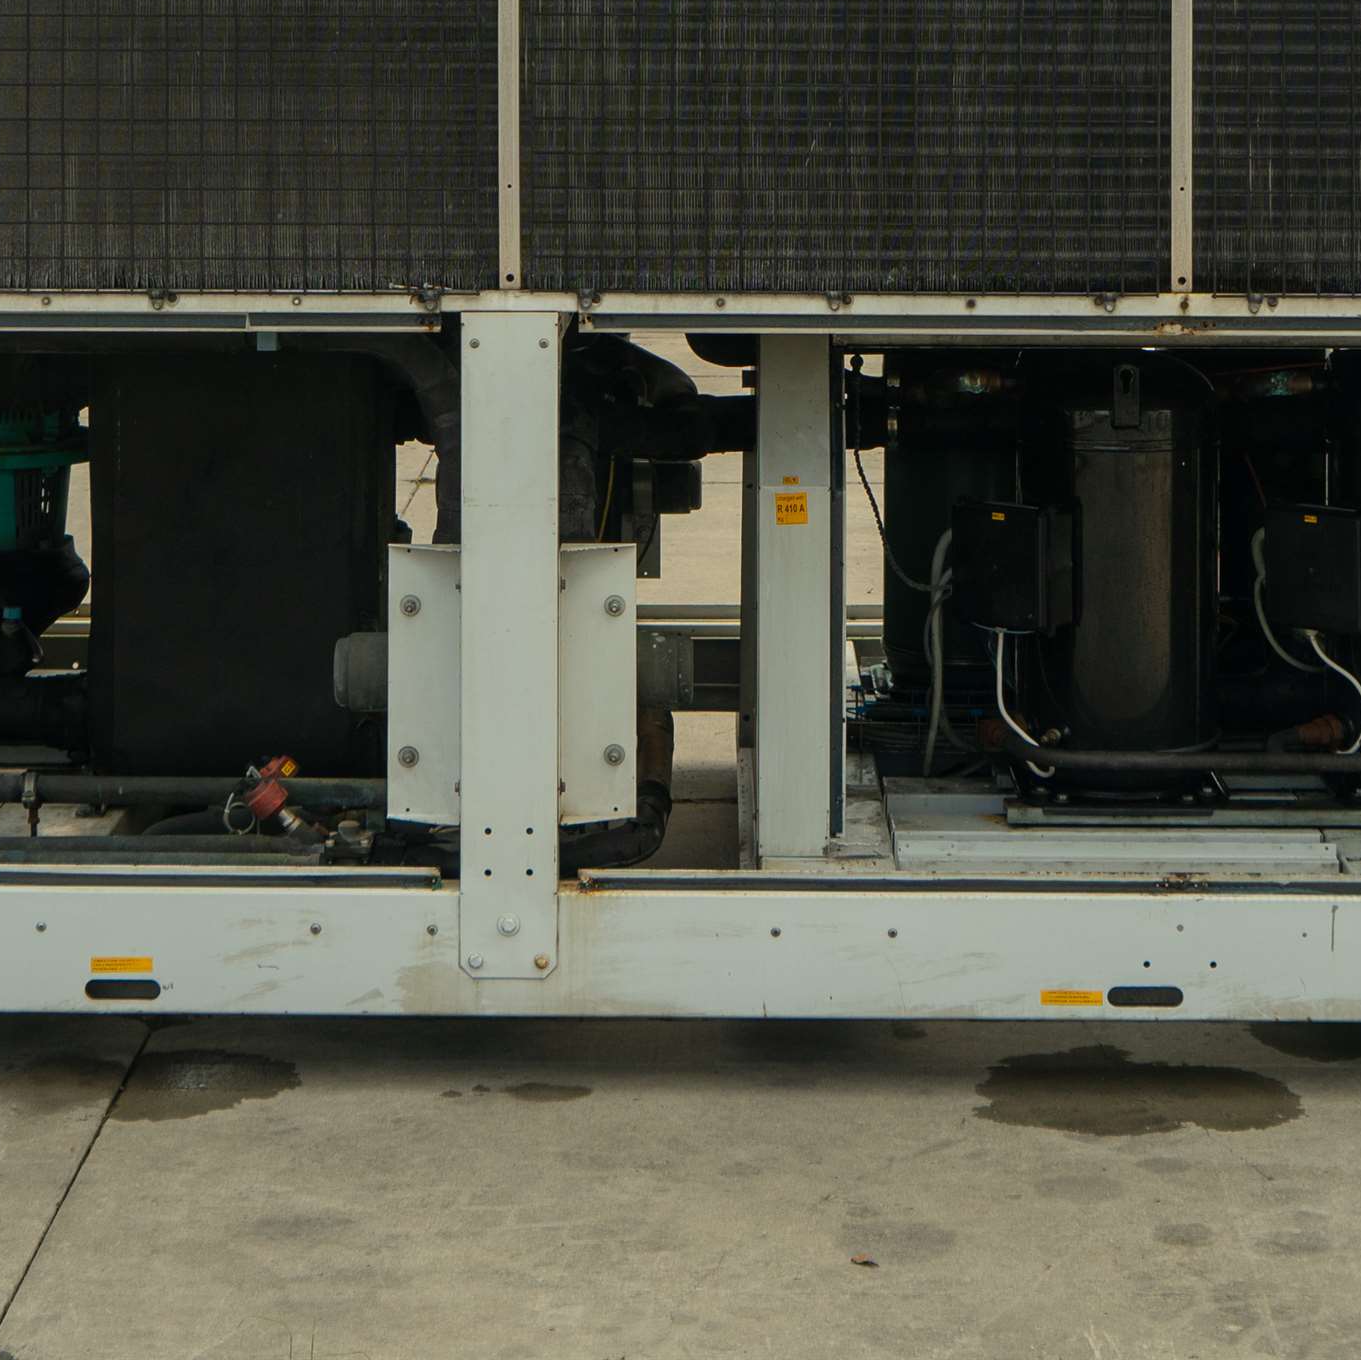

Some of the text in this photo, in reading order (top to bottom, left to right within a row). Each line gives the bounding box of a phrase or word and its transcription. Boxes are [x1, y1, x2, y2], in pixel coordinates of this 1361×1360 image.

[777, 504, 805, 513] R 410 A
